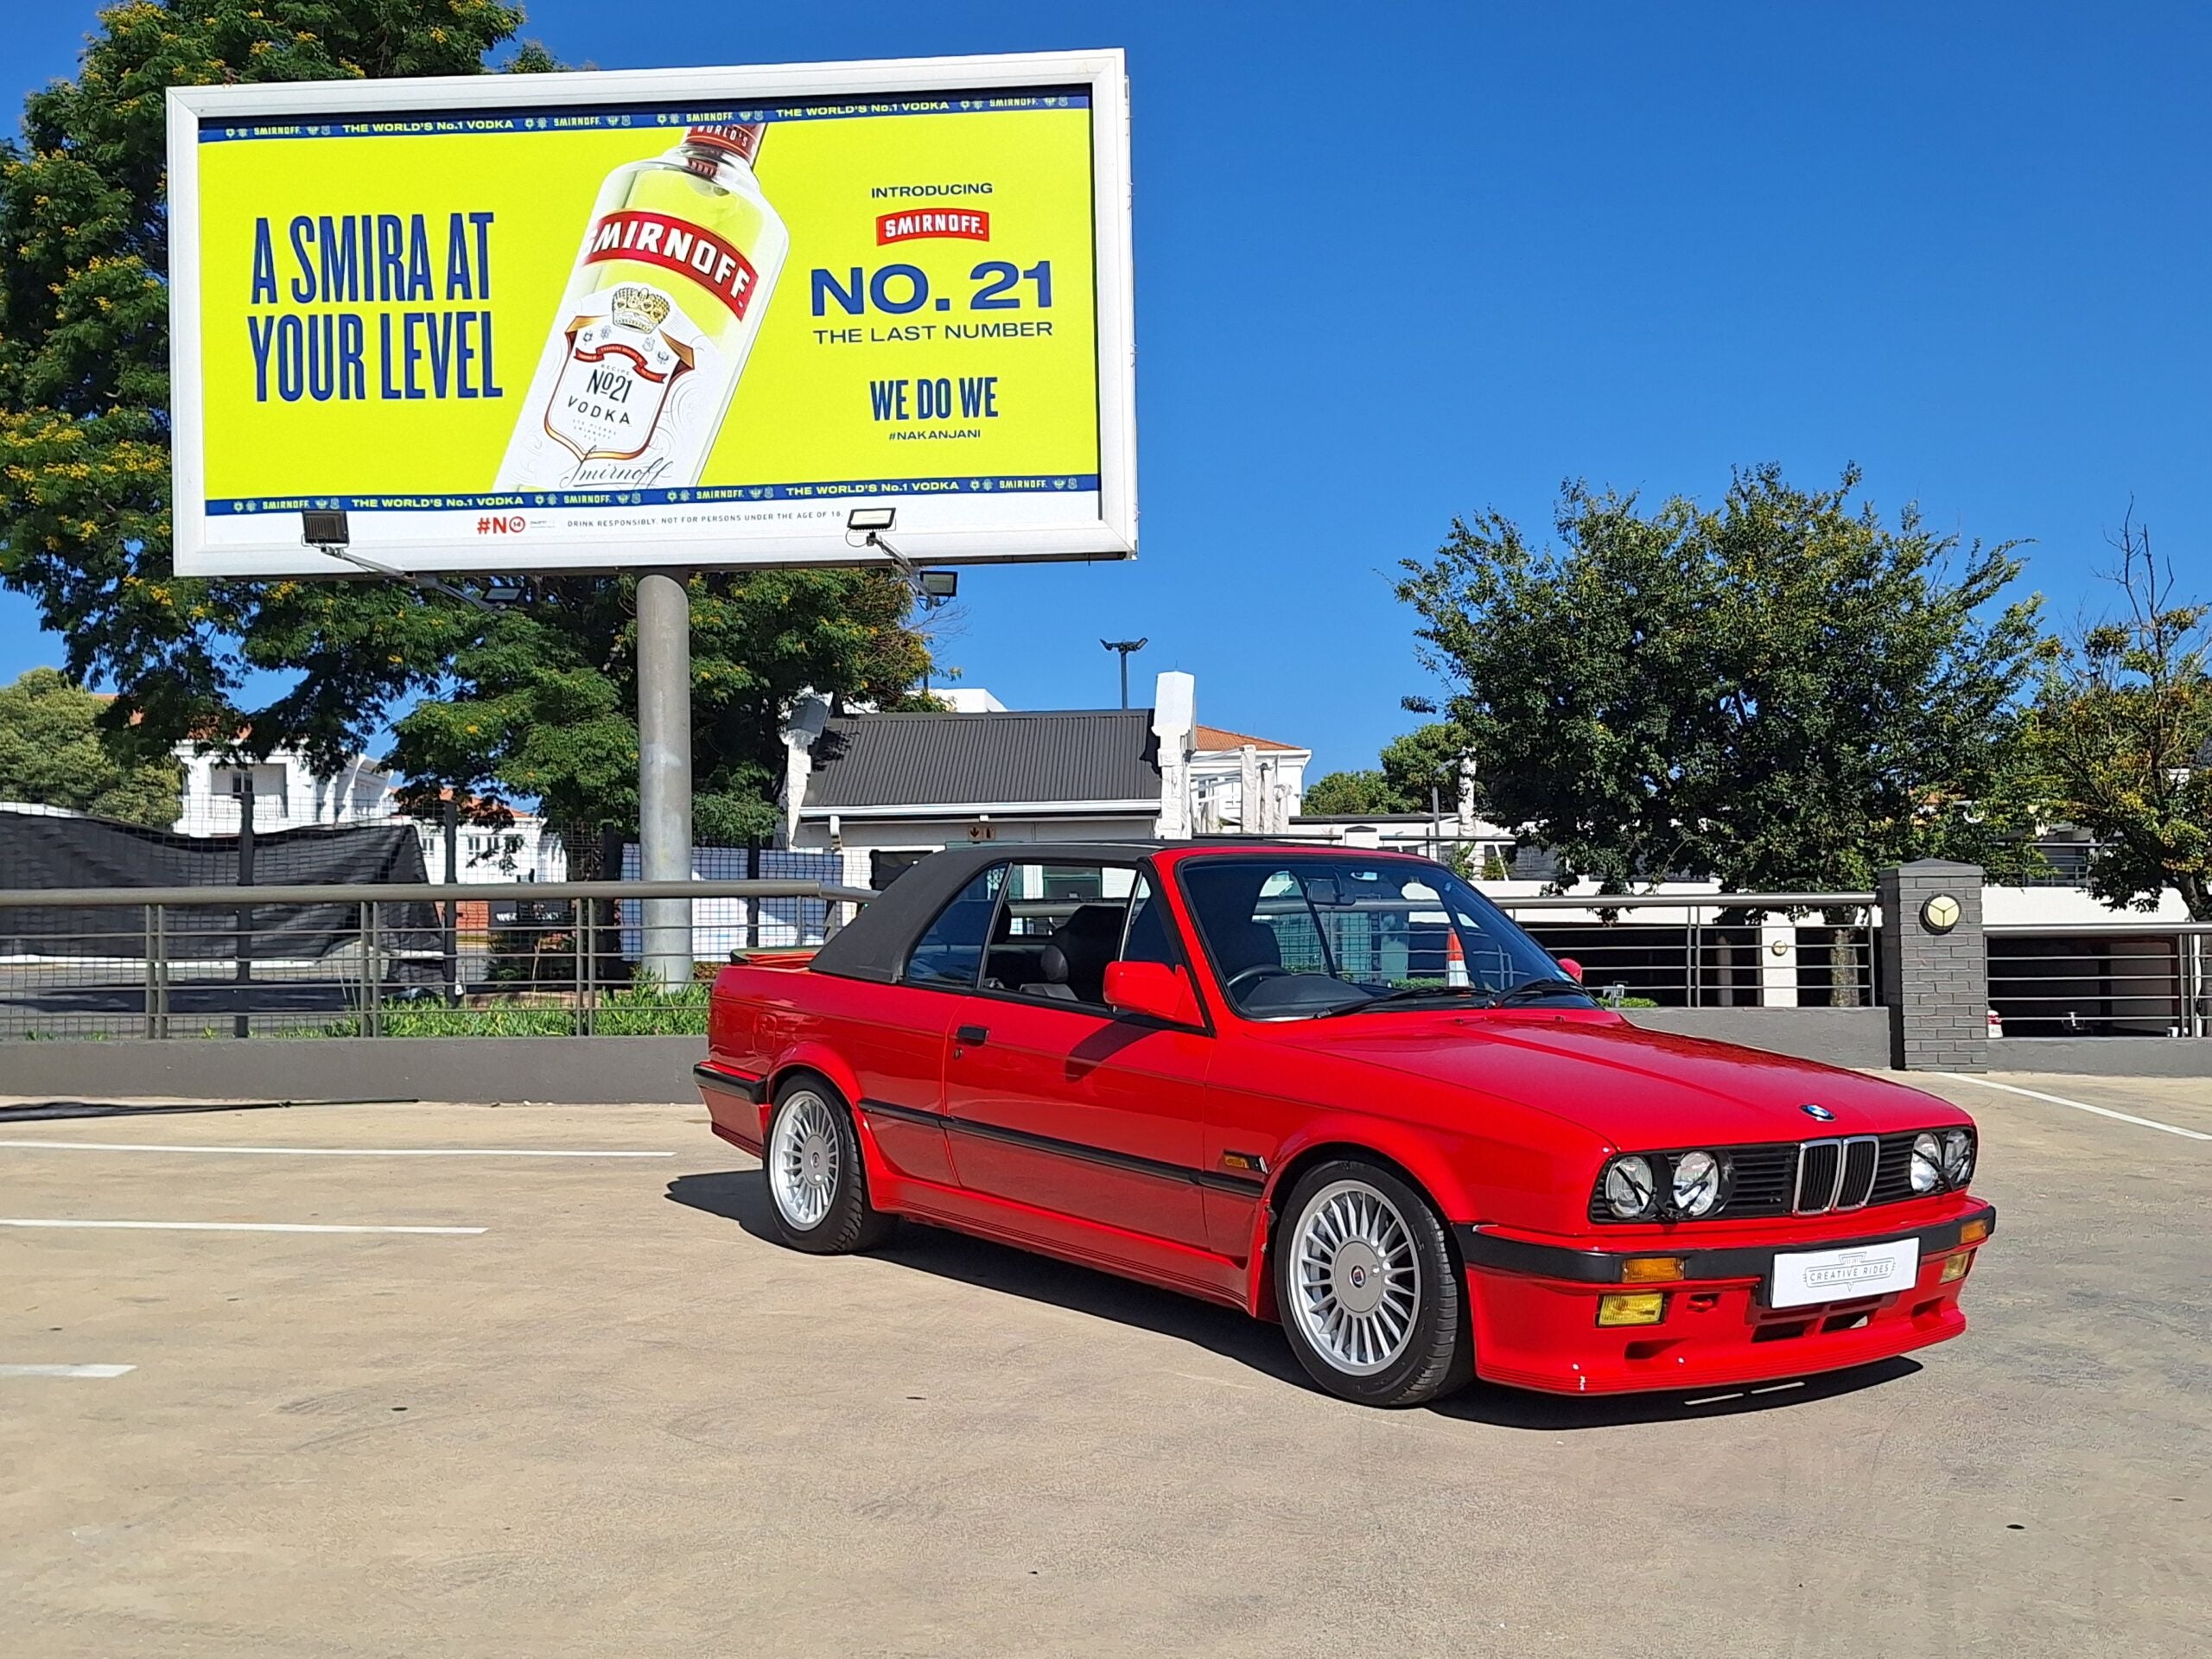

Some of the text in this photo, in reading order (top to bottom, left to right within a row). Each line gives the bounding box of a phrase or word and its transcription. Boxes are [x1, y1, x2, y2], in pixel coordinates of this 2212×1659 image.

[776, 108, 803, 118] THE
[805, 105, 867, 116] WORLD'S
[901, 101, 950, 111] VODKA
[342, 124, 368, 133] THE
[372, 122, 433, 132] WORLD'S
[467, 119, 514, 130] VODKA
[872, 183, 993, 199] INTRODUCING
[251, 212, 494, 304] A SMIRA AT
[811, 261, 1052, 316] NO. 21
[813, 321, 1052, 344] THE LAST NUMBER
[247, 311, 503, 402] YOUR LEVEL
[869, 377, 999, 421] WE DO WE
[568, 395, 631, 424] VODKA
[889, 429, 981, 441] #NAKANJANI
[785, 487, 812, 496] THE
[815, 485, 877, 495] WORLD'S
[911, 481, 959, 491] VODKA
[352, 499, 378, 507] THE
[381, 499, 442, 508] WORLD'S
[476, 496, 524, 506] VODKA
[1810, 1262, 1889, 1281] CREATIVE RIDES
